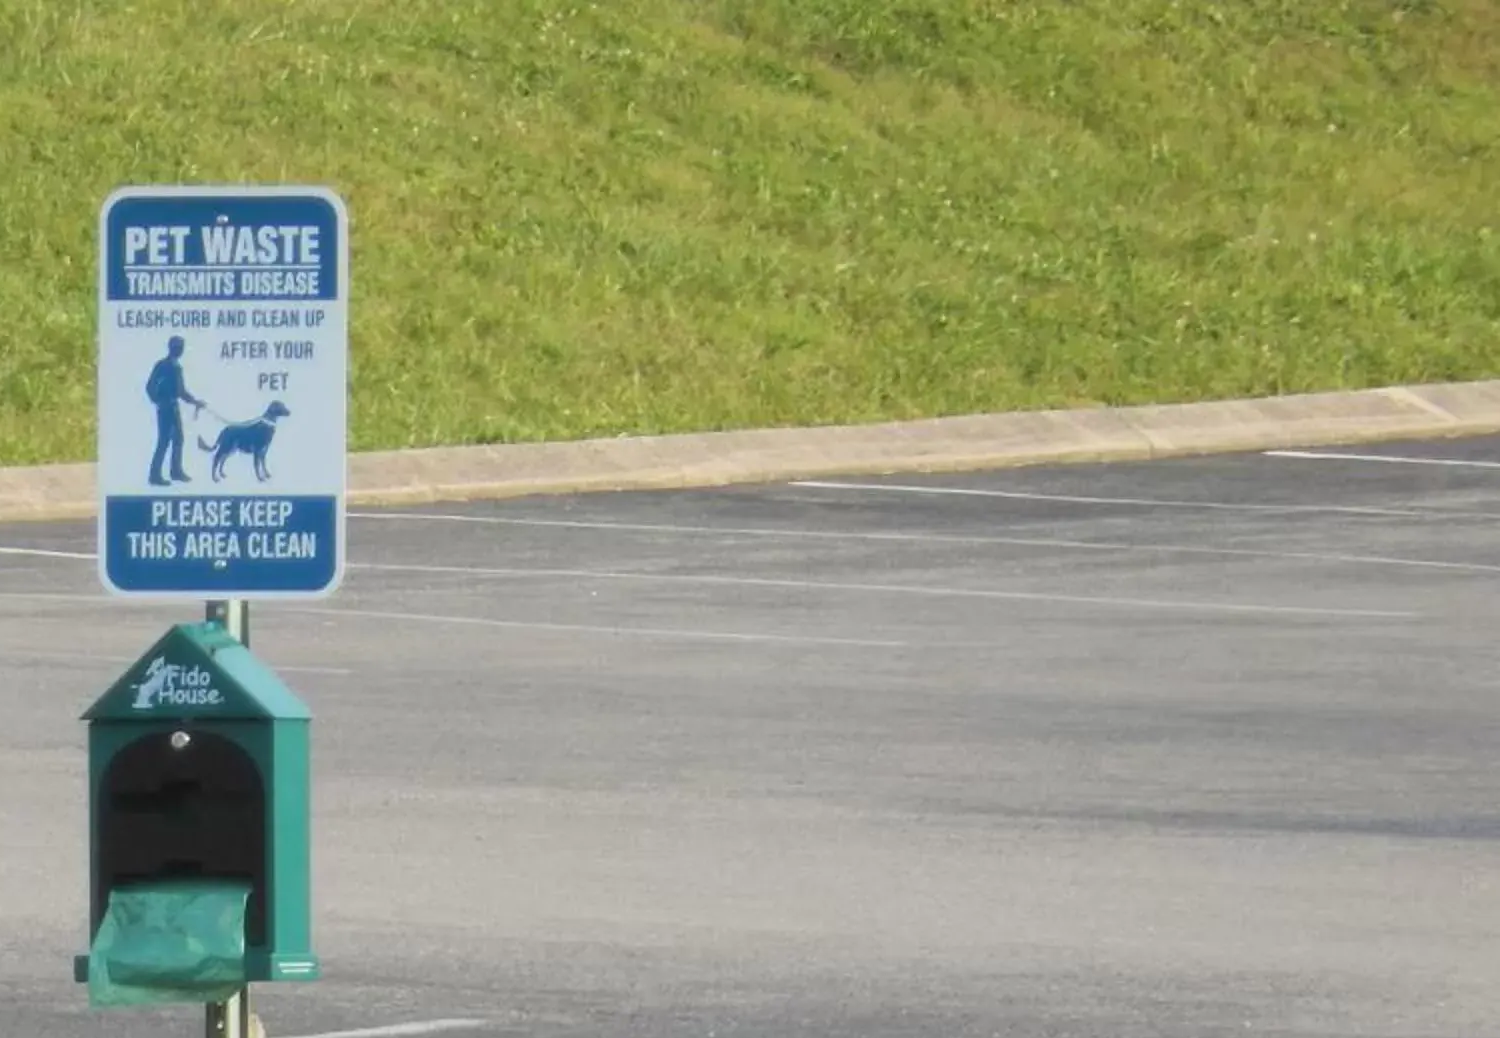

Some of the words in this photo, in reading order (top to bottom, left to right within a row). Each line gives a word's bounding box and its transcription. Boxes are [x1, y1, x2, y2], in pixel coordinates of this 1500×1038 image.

[125, 226, 191, 265] PET
[202, 226, 320, 265] WASTE
[125, 271, 235, 296] TRANSMITS
[241, 271, 320, 296] DISEASE
[117, 309, 211, 329] LEASH-CURB
[217, 309, 247, 329] AND
[252, 309, 300, 329] CLEAN
[305, 309, 325, 329] UP
[220, 341, 269, 360] AFTER
[274, 341, 314, 360] YOUR
[258, 372, 289, 391] PET
[152, 501, 232, 527] PLEASE
[239, 501, 293, 527] KEEP
[127, 532, 177, 559] THIS
[183, 532, 241, 559] AREA
[247, 532, 317, 559] CLEAN
[167, 664, 211, 686] Fido
